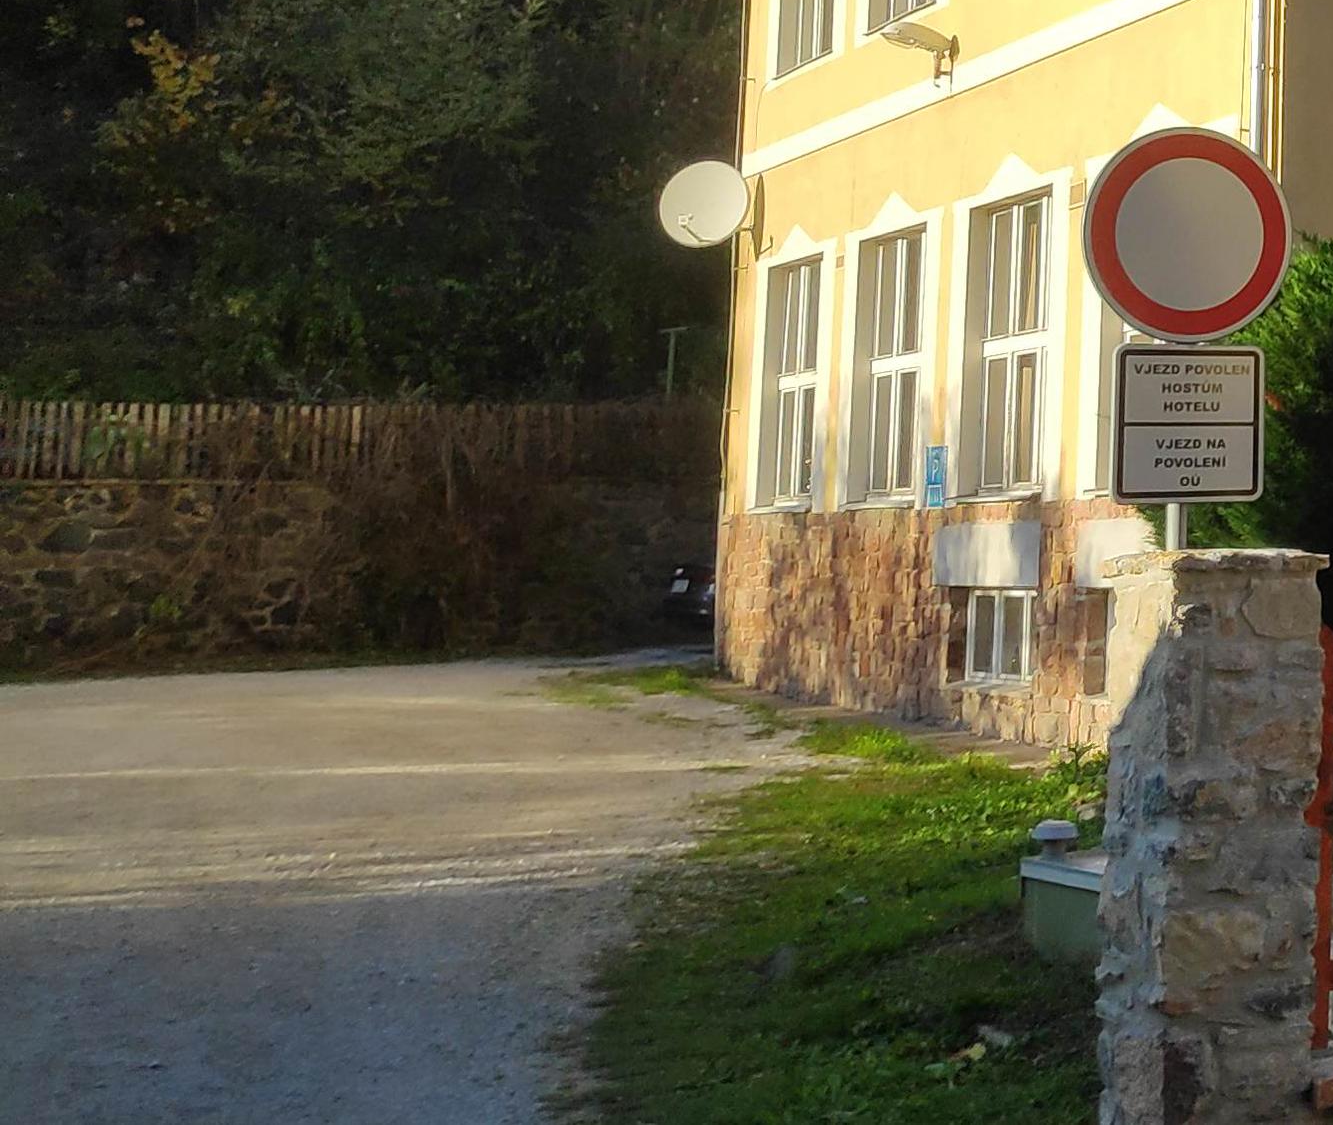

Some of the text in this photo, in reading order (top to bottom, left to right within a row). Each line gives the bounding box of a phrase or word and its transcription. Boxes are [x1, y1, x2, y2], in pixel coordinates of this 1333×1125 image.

[1134, 363, 1250, 376] VJEZD POVOLEN
[1163, 401, 1221, 413] HOTELU
[1155, 438, 1226, 450] VJEZD NA
[1154, 455, 1226, 469] POVOLENÍ
